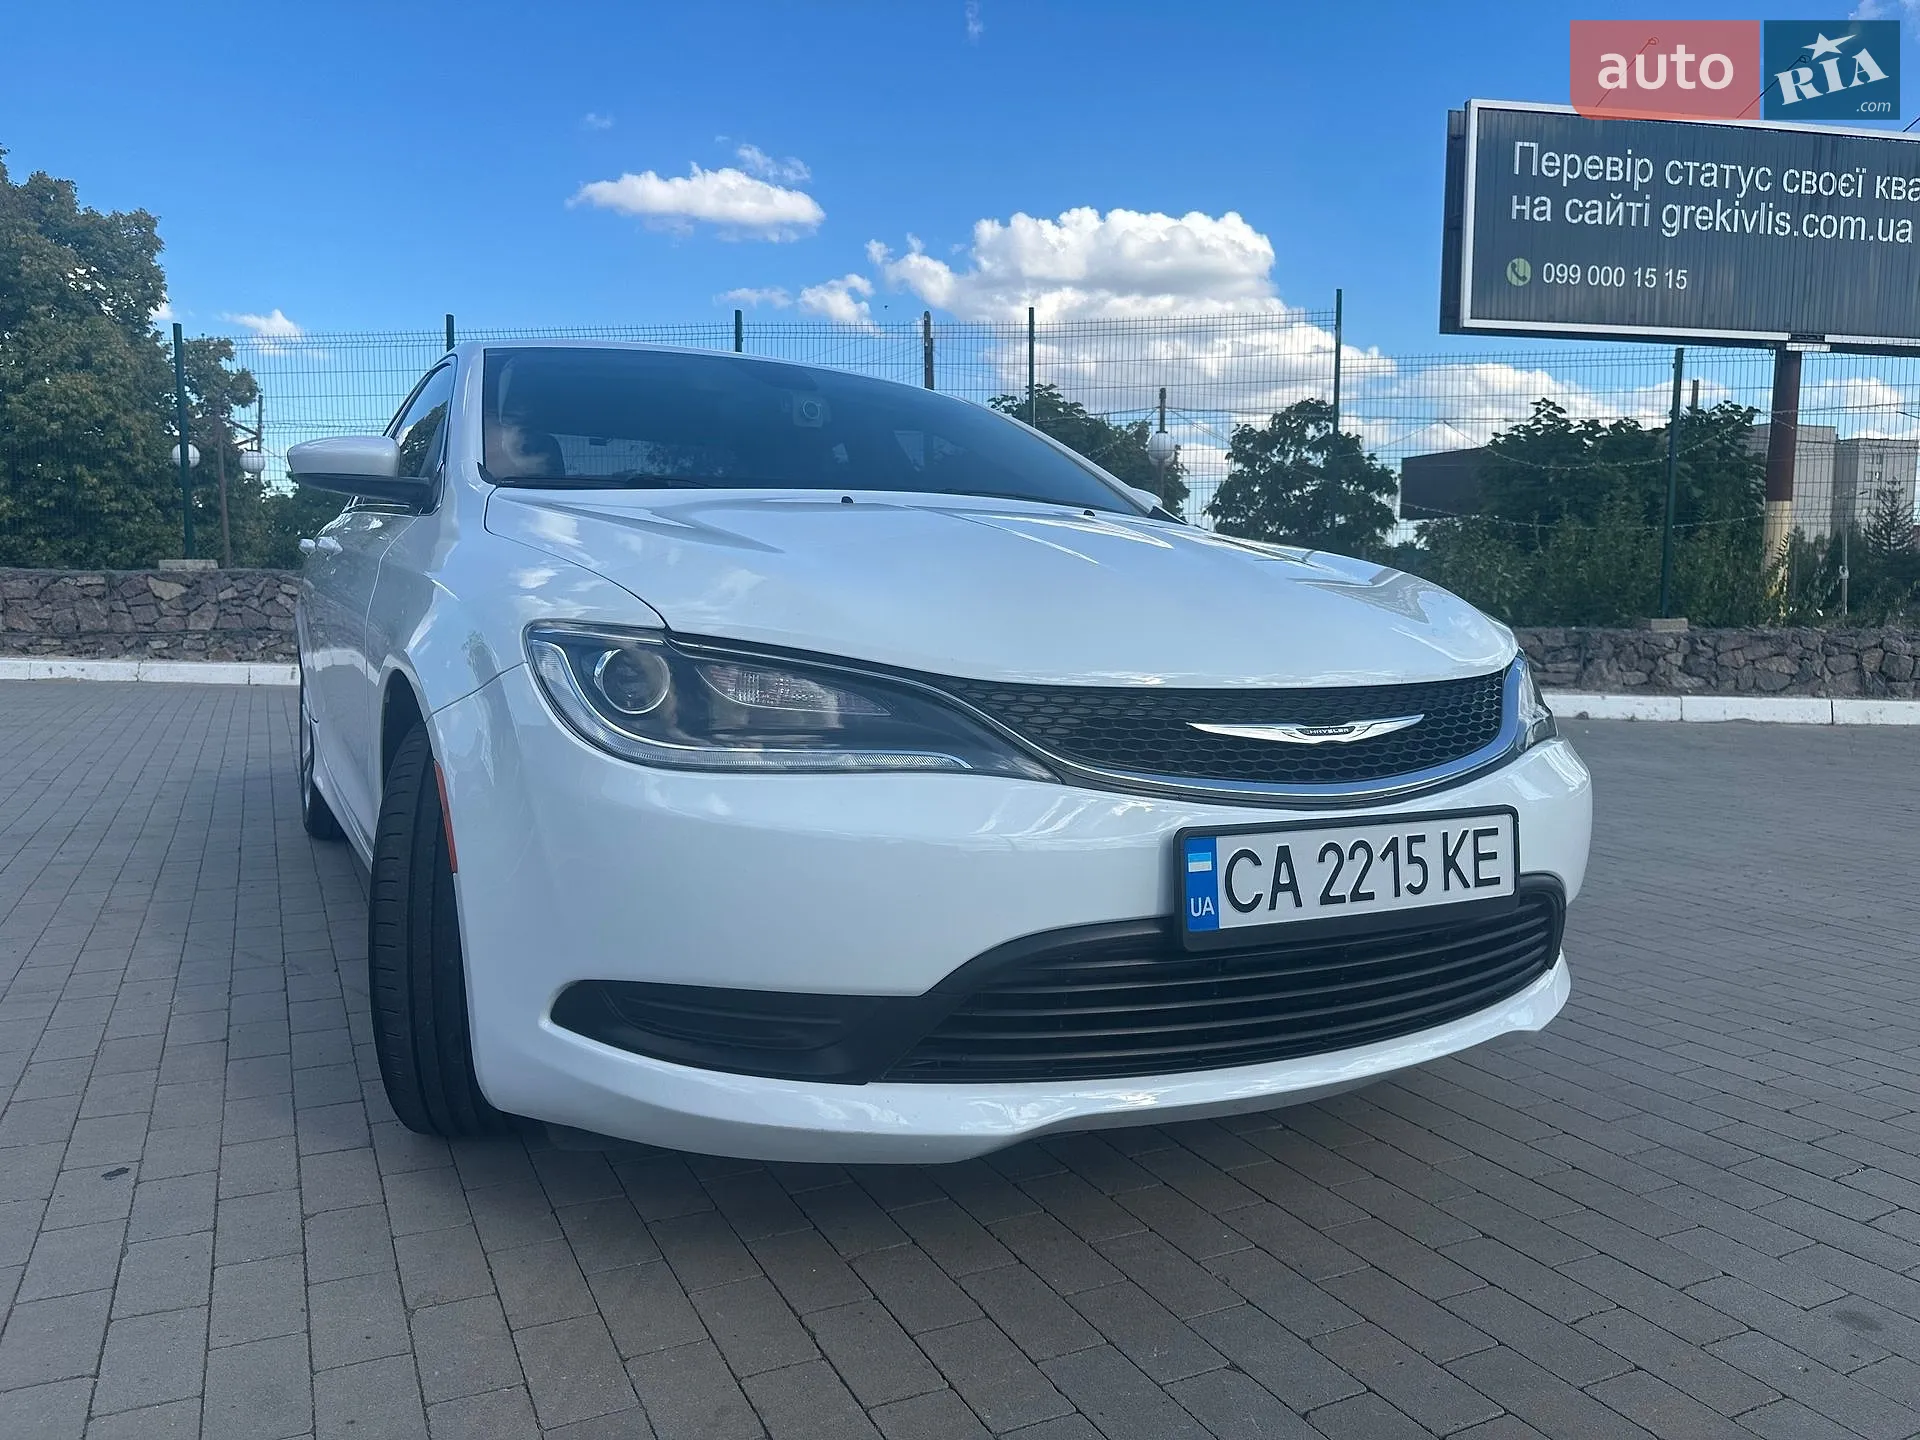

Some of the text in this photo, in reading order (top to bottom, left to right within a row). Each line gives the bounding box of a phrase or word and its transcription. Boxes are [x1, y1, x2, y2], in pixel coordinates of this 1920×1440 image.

[1513, 142, 1654, 191] Перевір
[1664, 158, 1772, 199] статус
[1782, 167, 1867, 198] своєї
[1511, 194, 1913, 244] на сайті grekivlis.com.ua
[1542, 262, 1688, 290] 099 000 15 15
[1224, 826, 1501, 914] CA 2215 KE
[1190, 897, 1215, 916] UA
